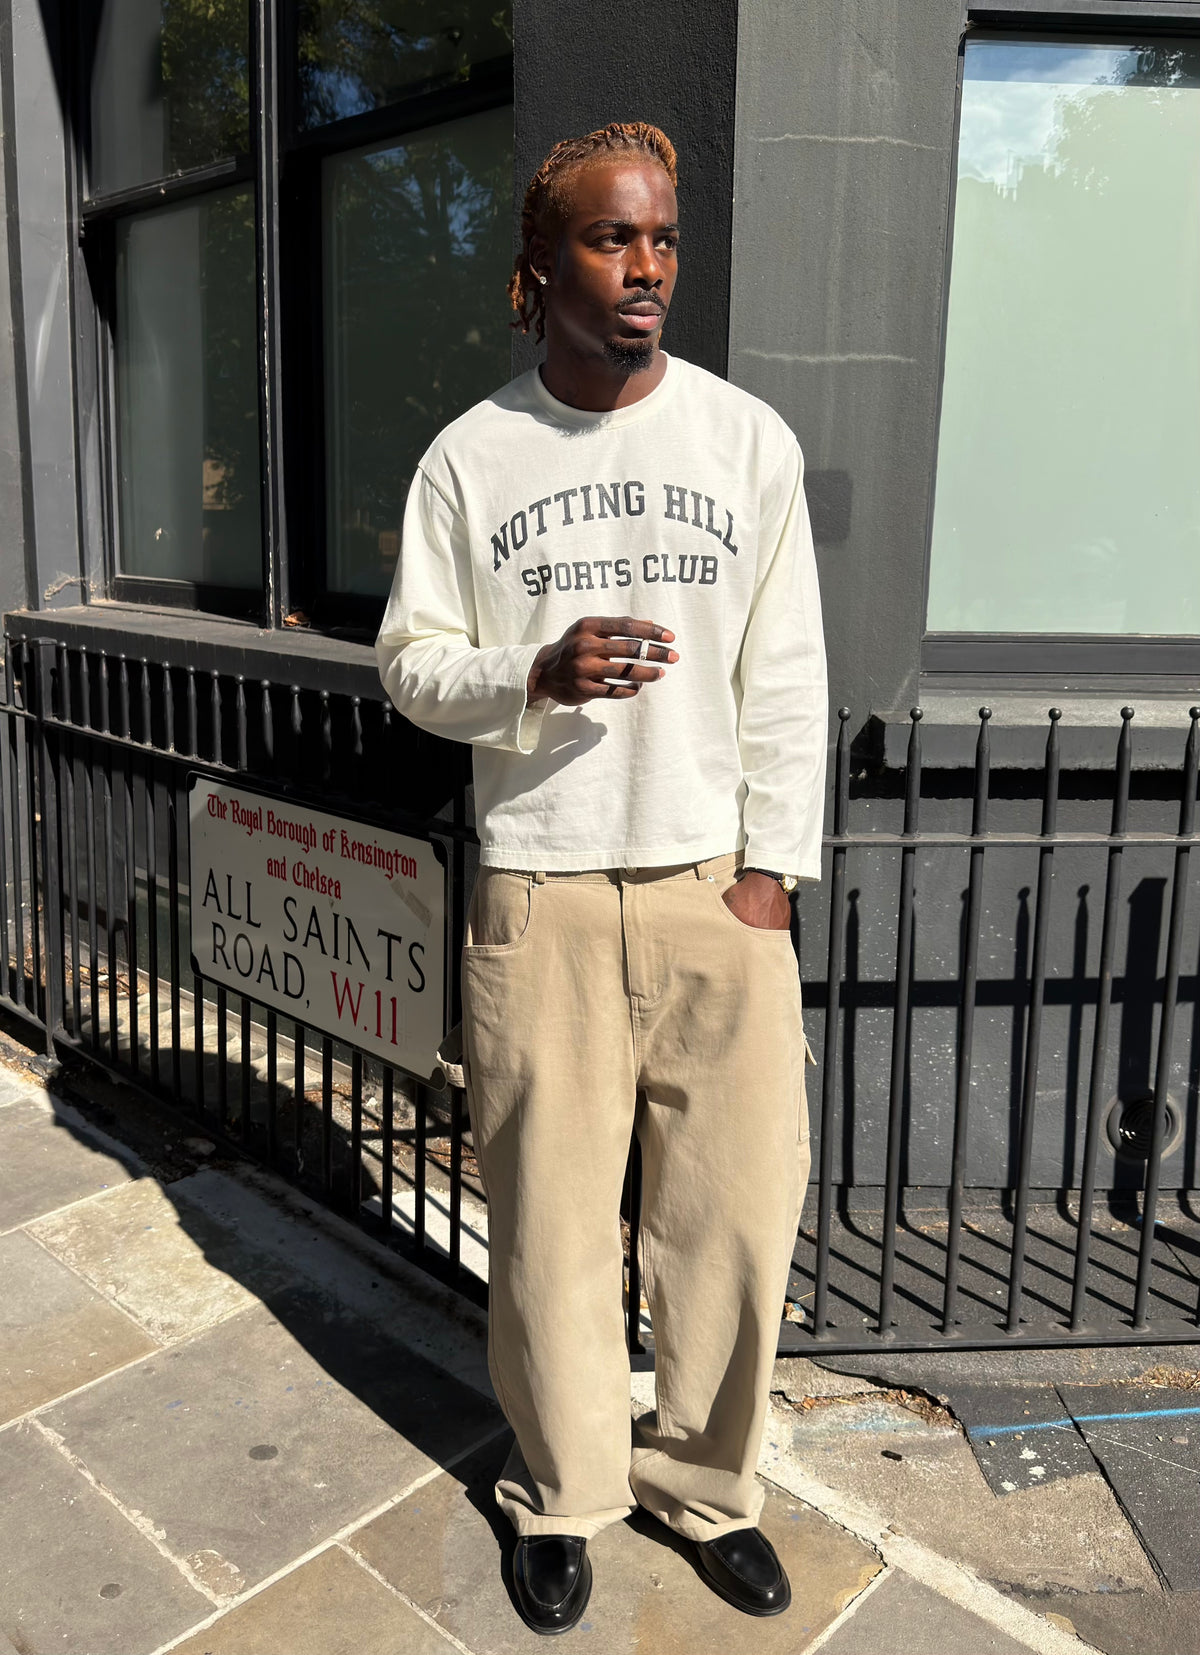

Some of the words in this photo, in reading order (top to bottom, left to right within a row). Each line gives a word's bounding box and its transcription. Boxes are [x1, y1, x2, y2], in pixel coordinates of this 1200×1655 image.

[490, 480, 645, 573] NOTTING
[663, 483, 739, 557] HILL
[521, 558, 632, 597] SPORTS
[642, 553, 718, 585] CLUB
[207, 793, 228, 820] The
[230, 799, 263, 837] Royal
[267, 810, 317, 853] Borough
[322, 829, 335, 854] of
[340, 830, 417, 880] Kensington
[266, 856, 287, 882] and
[292, 861, 342, 900] Chelsea
[202, 867, 261, 928] ALL
[283, 896, 426, 993] SAINTS
[211, 921, 310, 1009] ROAD,
[330, 970, 399, 1046] W.11
